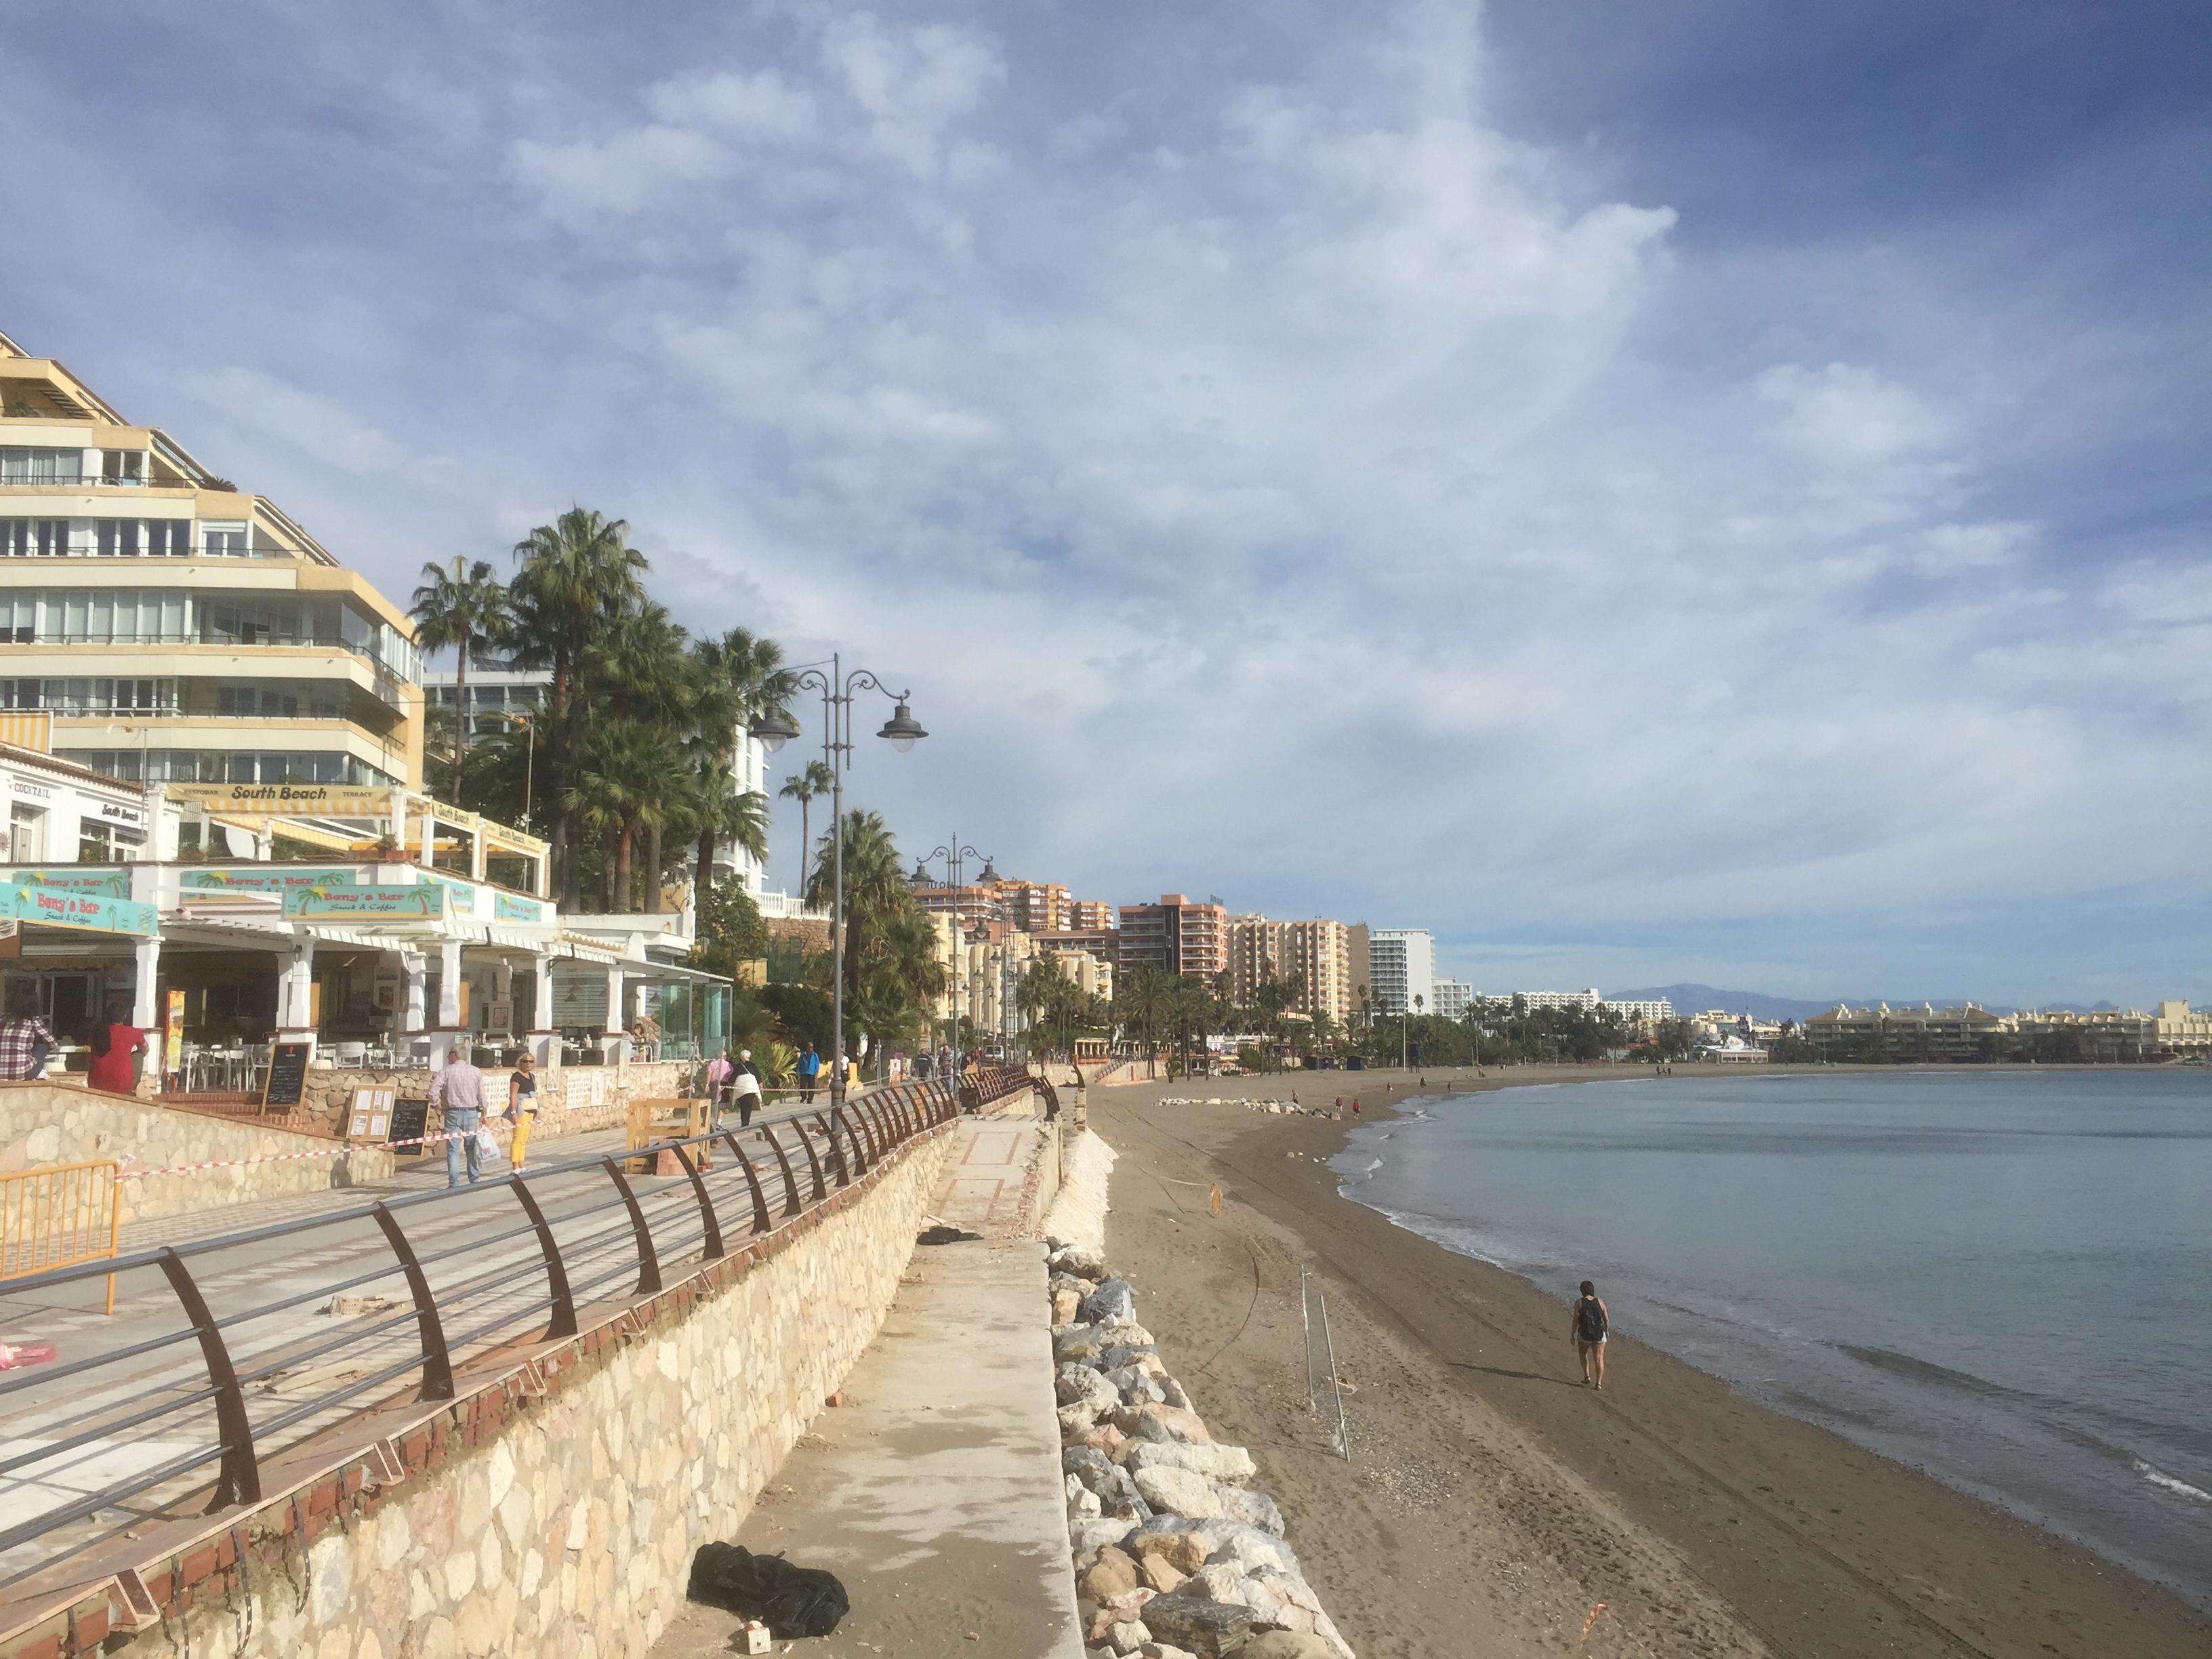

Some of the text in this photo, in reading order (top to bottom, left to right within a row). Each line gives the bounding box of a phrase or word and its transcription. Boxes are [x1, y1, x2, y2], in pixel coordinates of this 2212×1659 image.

[14, 783, 52, 798] COCKTAIL
[231, 785, 275, 800] South
[279, 786, 327, 800] Beach
[102, 804, 139, 822] South Beach
[83, 878, 104, 886] Bar
[378, 893, 405, 901] Bar
[79, 898, 100, 914] Bar
[44, 912, 64, 920] Snack
